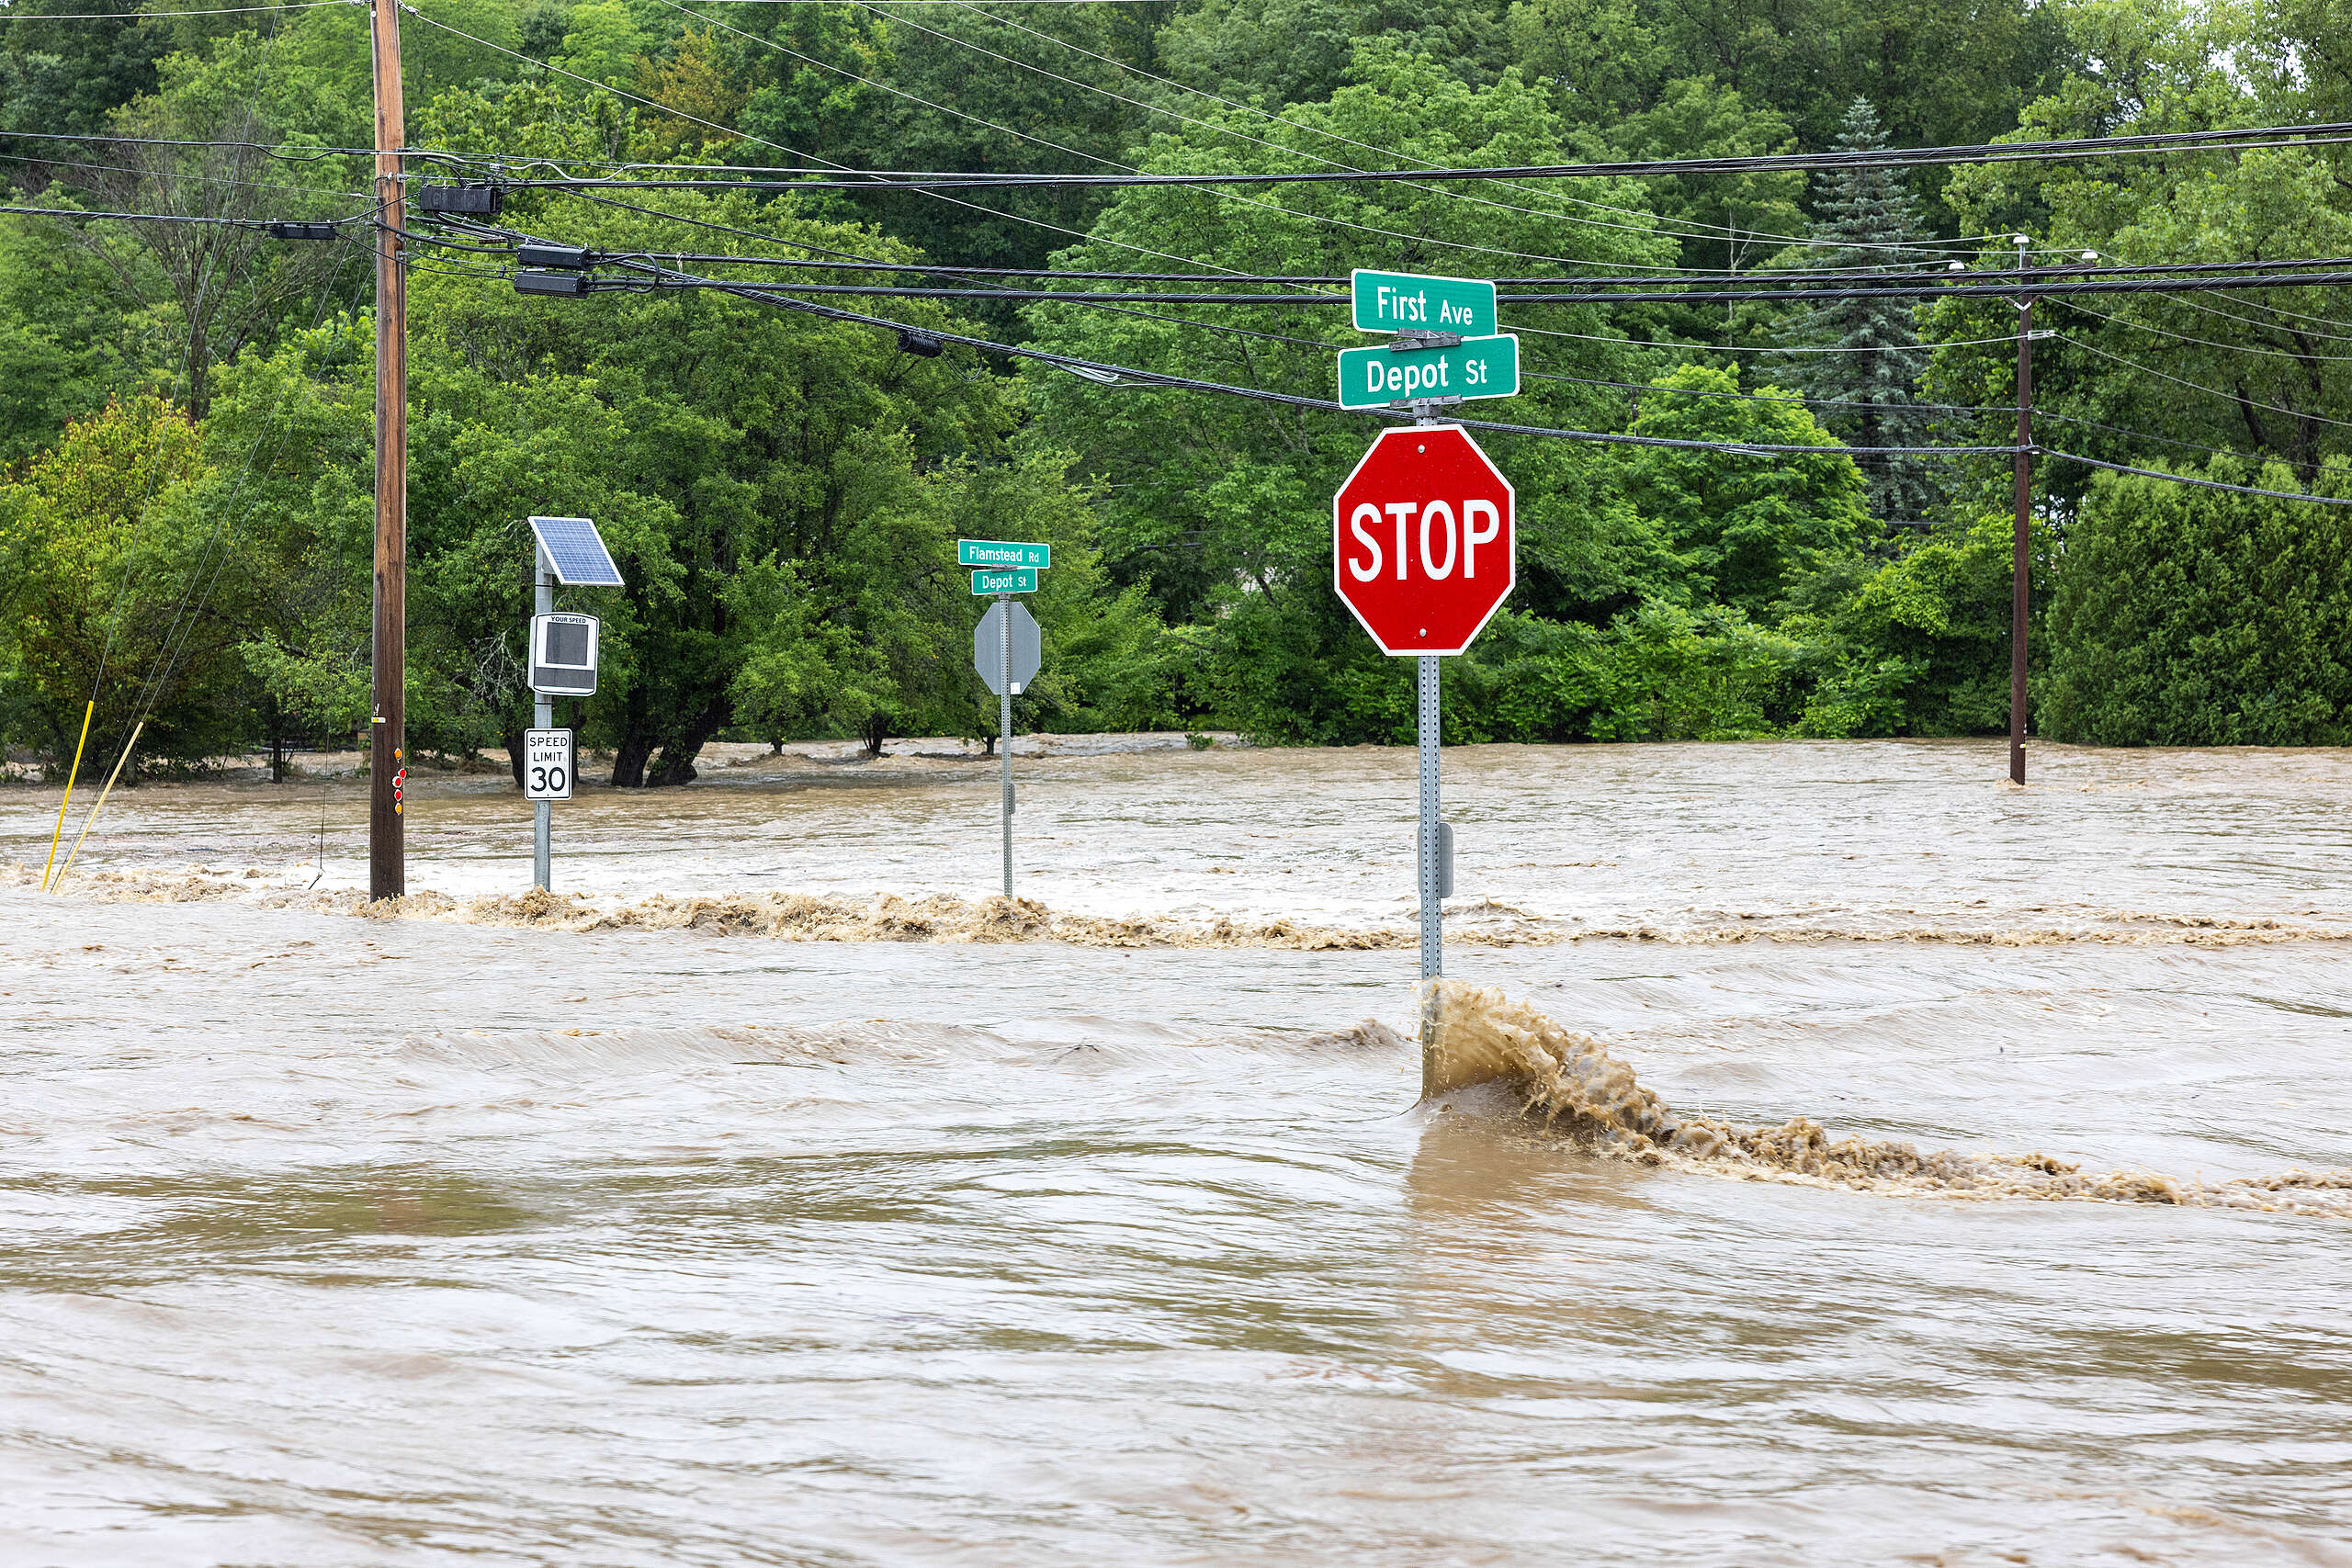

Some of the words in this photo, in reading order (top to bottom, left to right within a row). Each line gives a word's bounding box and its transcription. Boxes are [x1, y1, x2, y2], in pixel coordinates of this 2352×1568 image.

[1377, 286, 1427, 322] First
[1440, 299, 1473, 325] Ave
[1366, 354, 1449, 398] Depot
[1465, 358, 1487, 385] St
[1348, 499, 1500, 582] STOP
[969, 546, 1023, 562] Flamstead
[1028, 552, 1039, 563] Rd
[982, 574, 1013, 591] Depot
[1017, 576, 1027, 587] St
[529, 737, 568, 747] SPEED
[533, 751, 563, 761] LIMIT
[530, 767, 566, 792] 30
